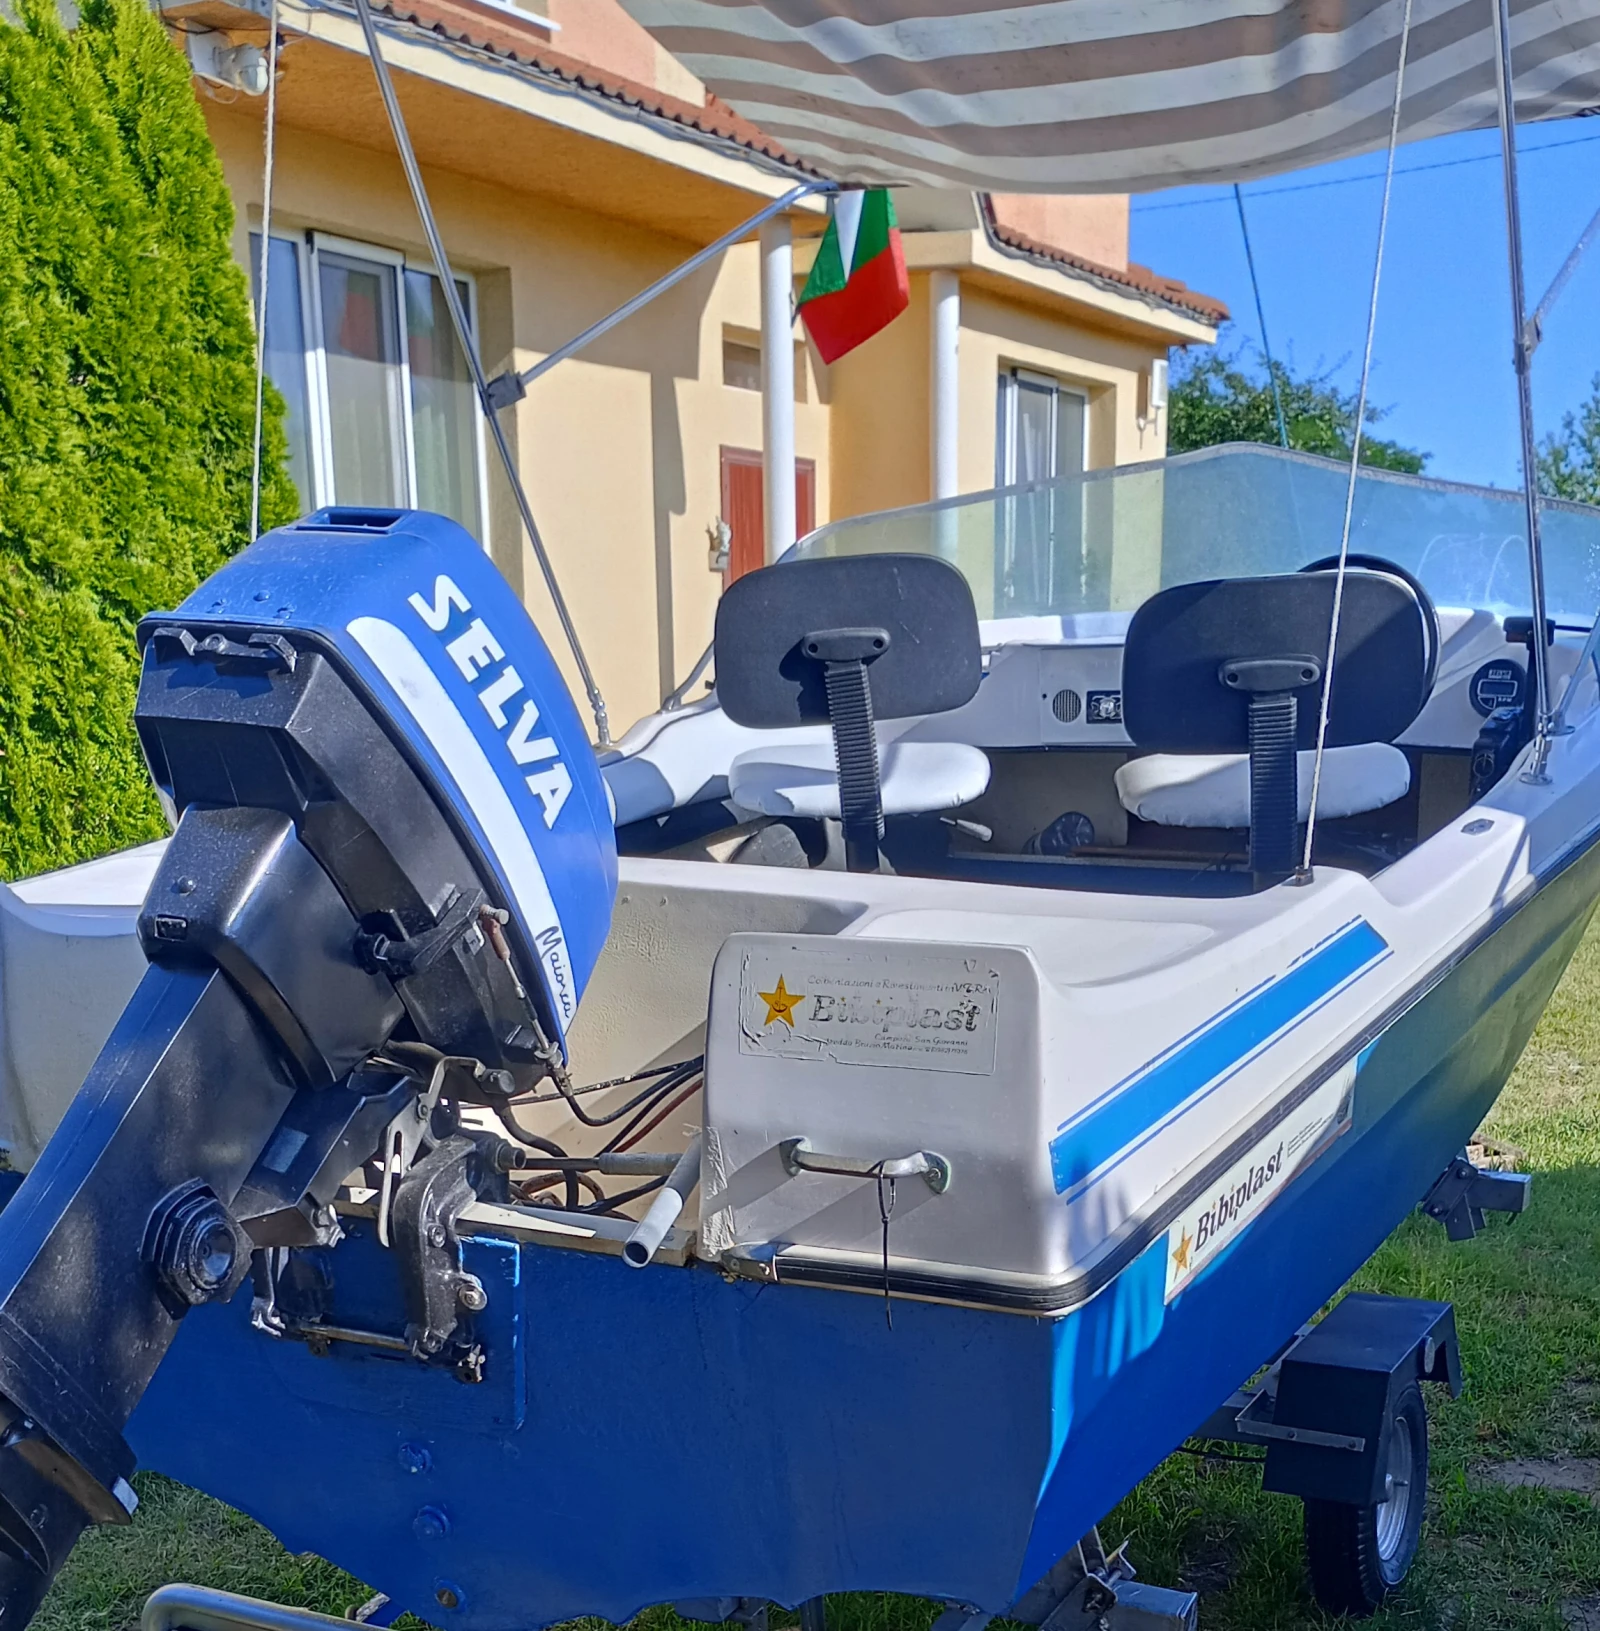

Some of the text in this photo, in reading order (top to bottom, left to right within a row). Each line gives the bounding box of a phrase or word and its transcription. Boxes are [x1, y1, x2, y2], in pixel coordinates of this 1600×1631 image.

[407, 574, 573, 830] SELVA
[915, 1035, 931, 1045] San
[932, 1036, 968, 1047] Giovanni
[1194, 1141, 1284, 1252] Bibiplast
